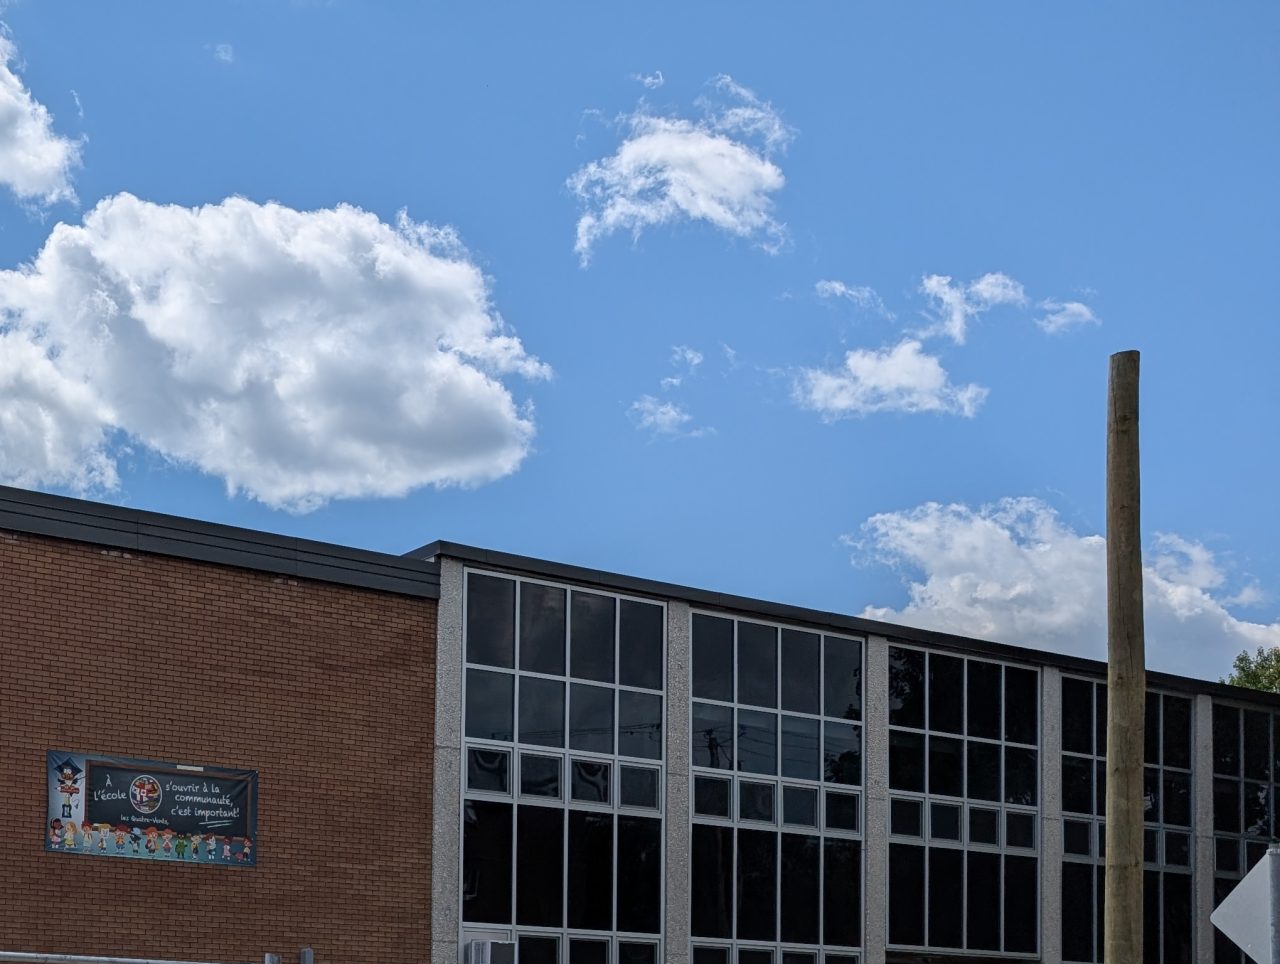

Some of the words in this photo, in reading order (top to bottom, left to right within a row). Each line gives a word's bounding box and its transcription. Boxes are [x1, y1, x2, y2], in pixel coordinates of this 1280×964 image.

[105, 774, 113, 787] À
[165, 780, 200, 793] s'ouvrir
[202, 781, 209, 793] à
[211, 783, 220, 794] la
[174, 793, 233, 807] communauté,
[171, 804, 192, 816] c'est
[194, 807, 240, 822] important!
